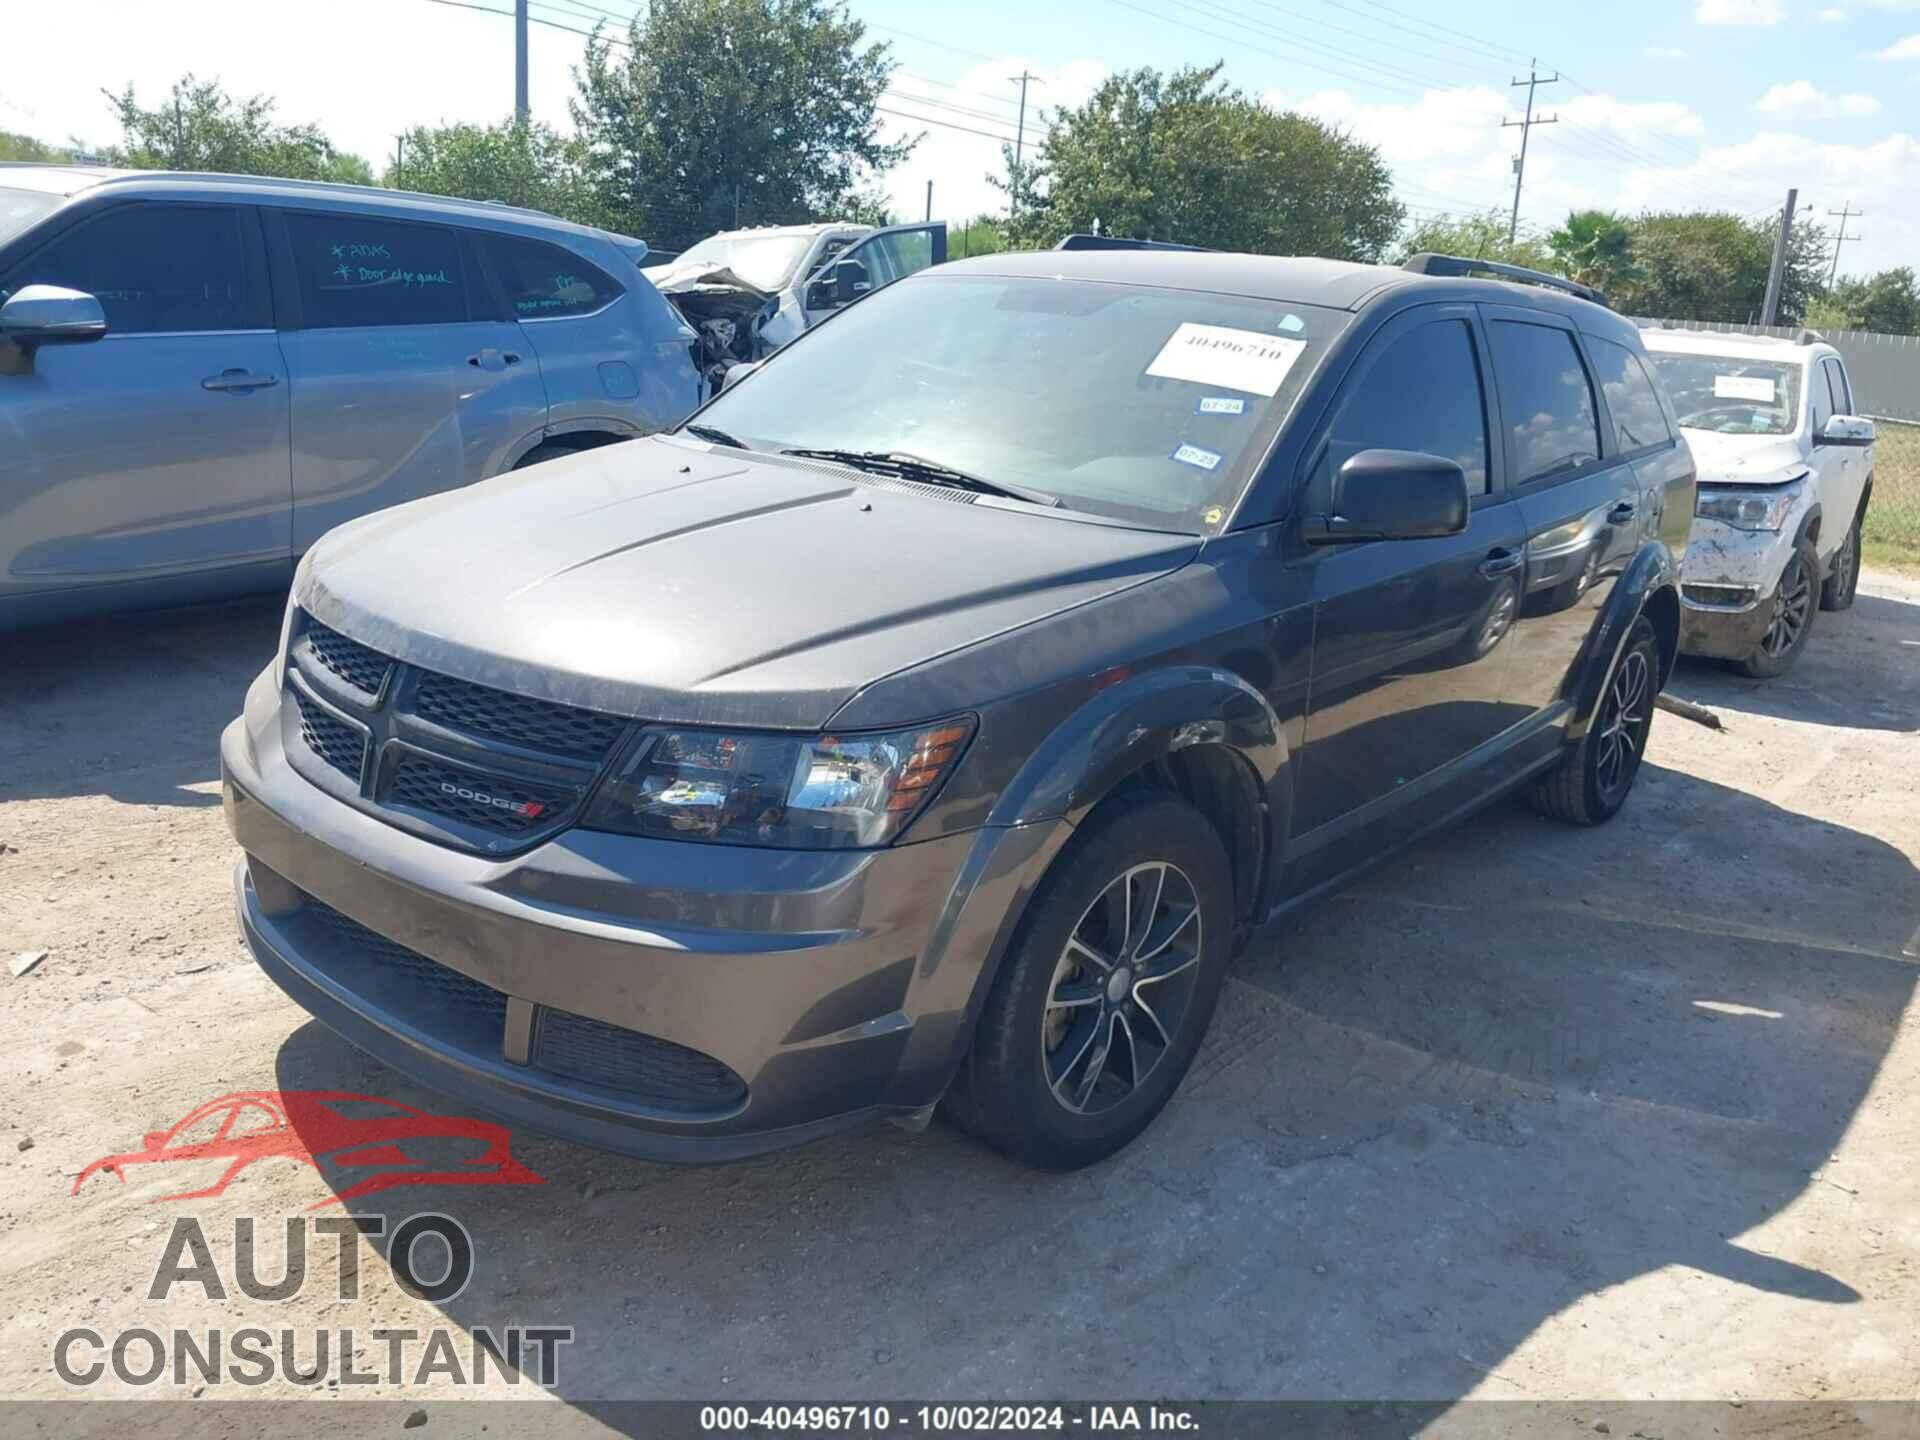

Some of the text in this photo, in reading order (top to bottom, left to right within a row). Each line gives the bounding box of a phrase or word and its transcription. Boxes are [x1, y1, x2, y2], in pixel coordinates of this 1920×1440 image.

[358, 267, 386, 281] Door
[1184, 336, 1282, 360] 40496710
[1202, 401, 1241, 411] 07-24
[441, 782, 528, 813] DODGE
